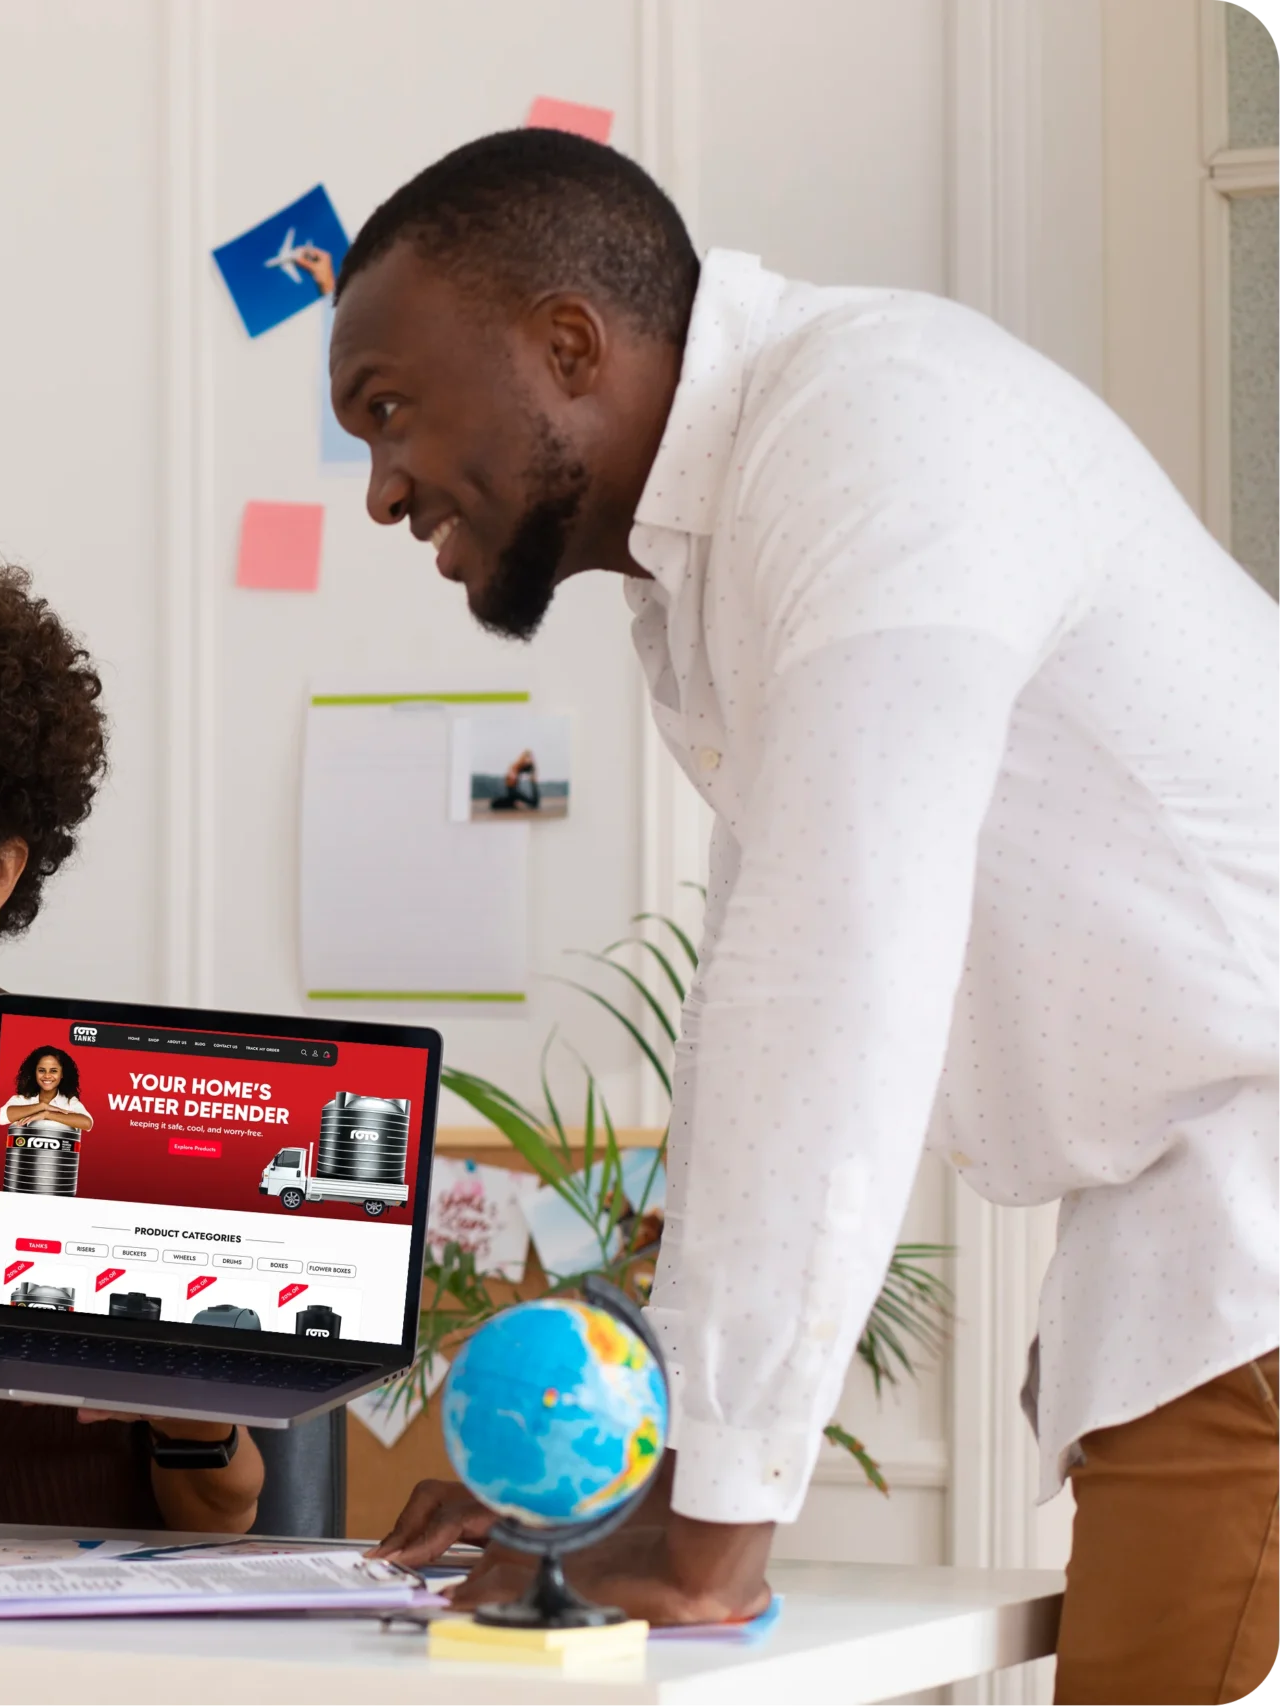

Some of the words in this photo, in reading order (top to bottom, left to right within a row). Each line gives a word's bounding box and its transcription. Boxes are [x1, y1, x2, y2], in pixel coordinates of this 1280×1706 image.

[74, 1034, 96, 1042] TANKS
[129, 1072, 187, 1094] YOUR
[191, 1078, 272, 1101] HOME'S
[107, 1093, 179, 1116] WATER
[184, 1100, 290, 1125] DEFENDER
[130, 1119, 159, 1130] keeping
[161, 1121, 166, 1129] it
[168, 1122, 185, 1132] safe,
[187, 1124, 205, 1133] cool,
[207, 1126, 222, 1134] and
[224, 1129, 264, 1138] worry-free.
[174, 1143, 194, 1151] Explore
[194, 1145, 216, 1153] Products
[134, 1227, 180, 1238] PRODUCT
[182, 1230, 242, 1243] CATEGORIES
[6, 1268, 18, 1278] 20%
[17, 1263, 25, 1271] Off
[309, 1265, 332, 1273] FLOWER
[98, 1276, 110, 1286] 20%
[108, 1270, 117, 1279] Off
[190, 1283, 201, 1294] 20%
[200, 1278, 208, 1286] Off
[281, 1291, 292, 1301] 20%
[291, 1286, 300, 1294] Off
